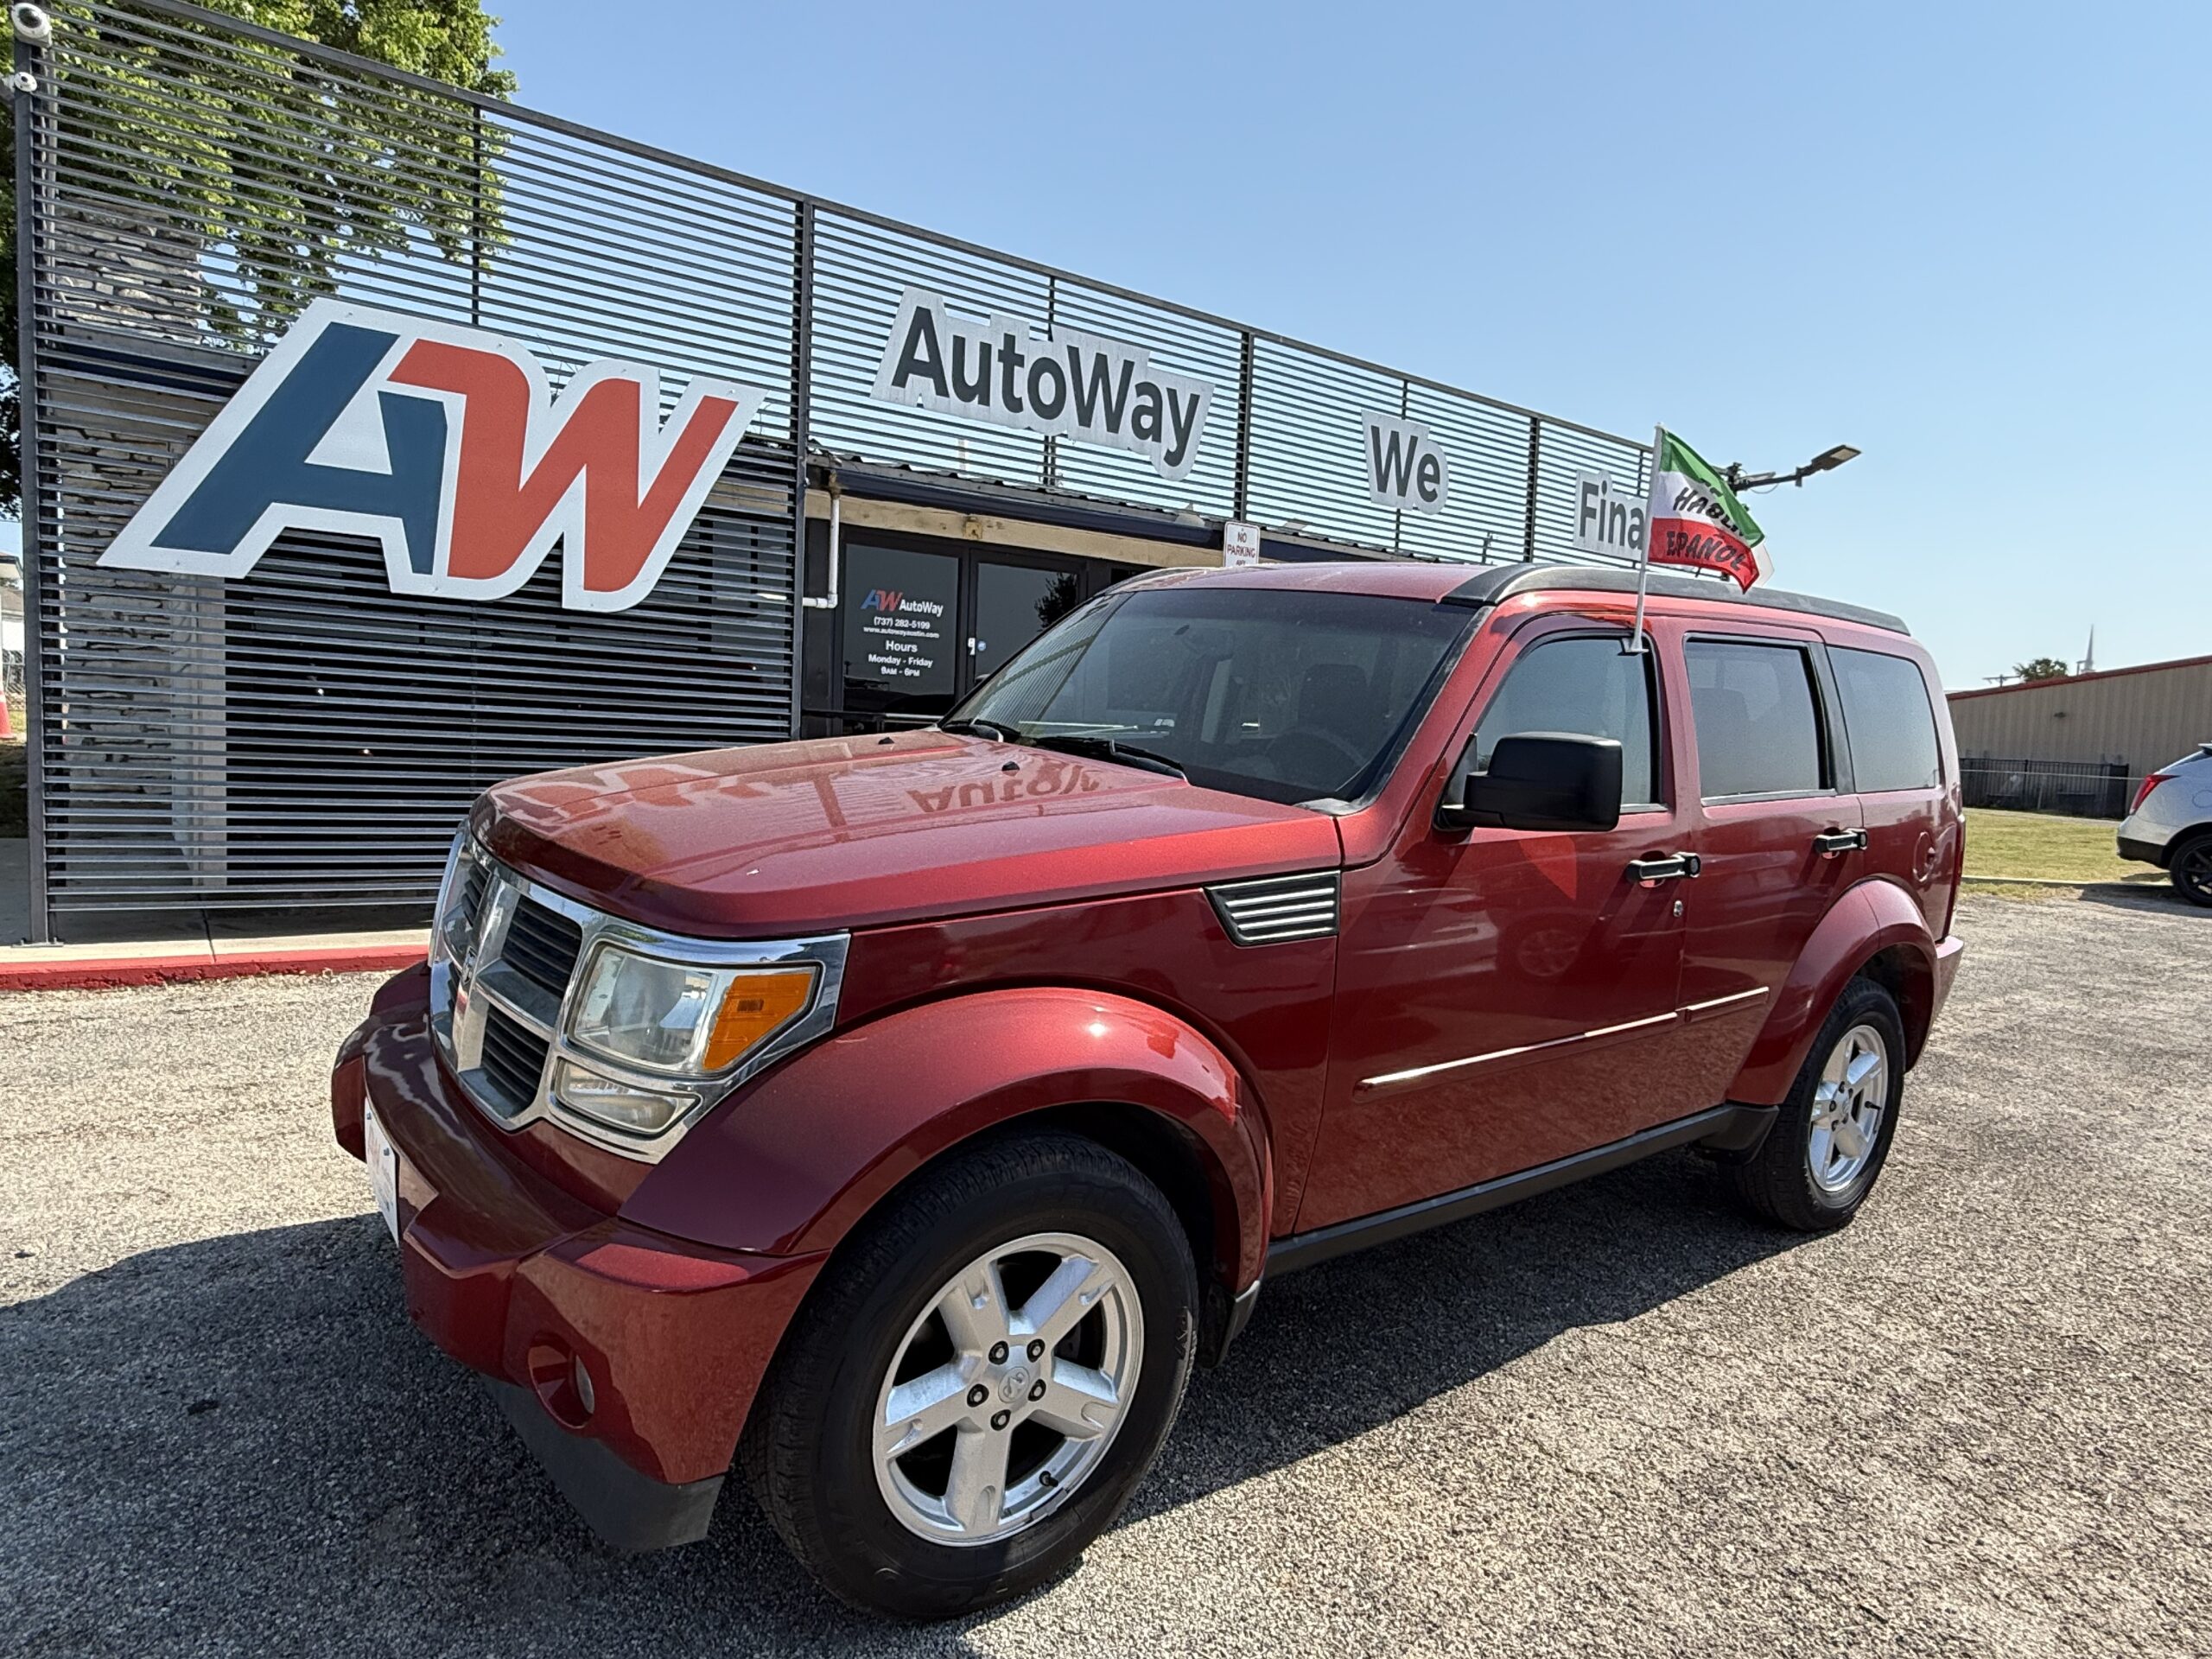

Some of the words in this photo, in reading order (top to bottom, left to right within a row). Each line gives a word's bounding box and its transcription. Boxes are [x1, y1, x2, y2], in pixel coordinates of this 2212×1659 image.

[891, 305, 1201, 468] AutoWay
[1370, 424, 1441, 503] We
[1579, 480, 1645, 551] Fina
[1237, 532, 1247, 543] NO
[1227, 544, 1255, 557] PARKING
[860, 589, 903, 612] AW
[899, 599, 944, 618] AutoWay
[874, 616, 893, 627] (737)
[894, 619, 931, 630] 282-5199
[886, 640, 918, 652] Hours
[868, 654, 901, 665] Monday
[908, 657, 933, 669] Friday
[904, 668, 920, 677] 6PM
